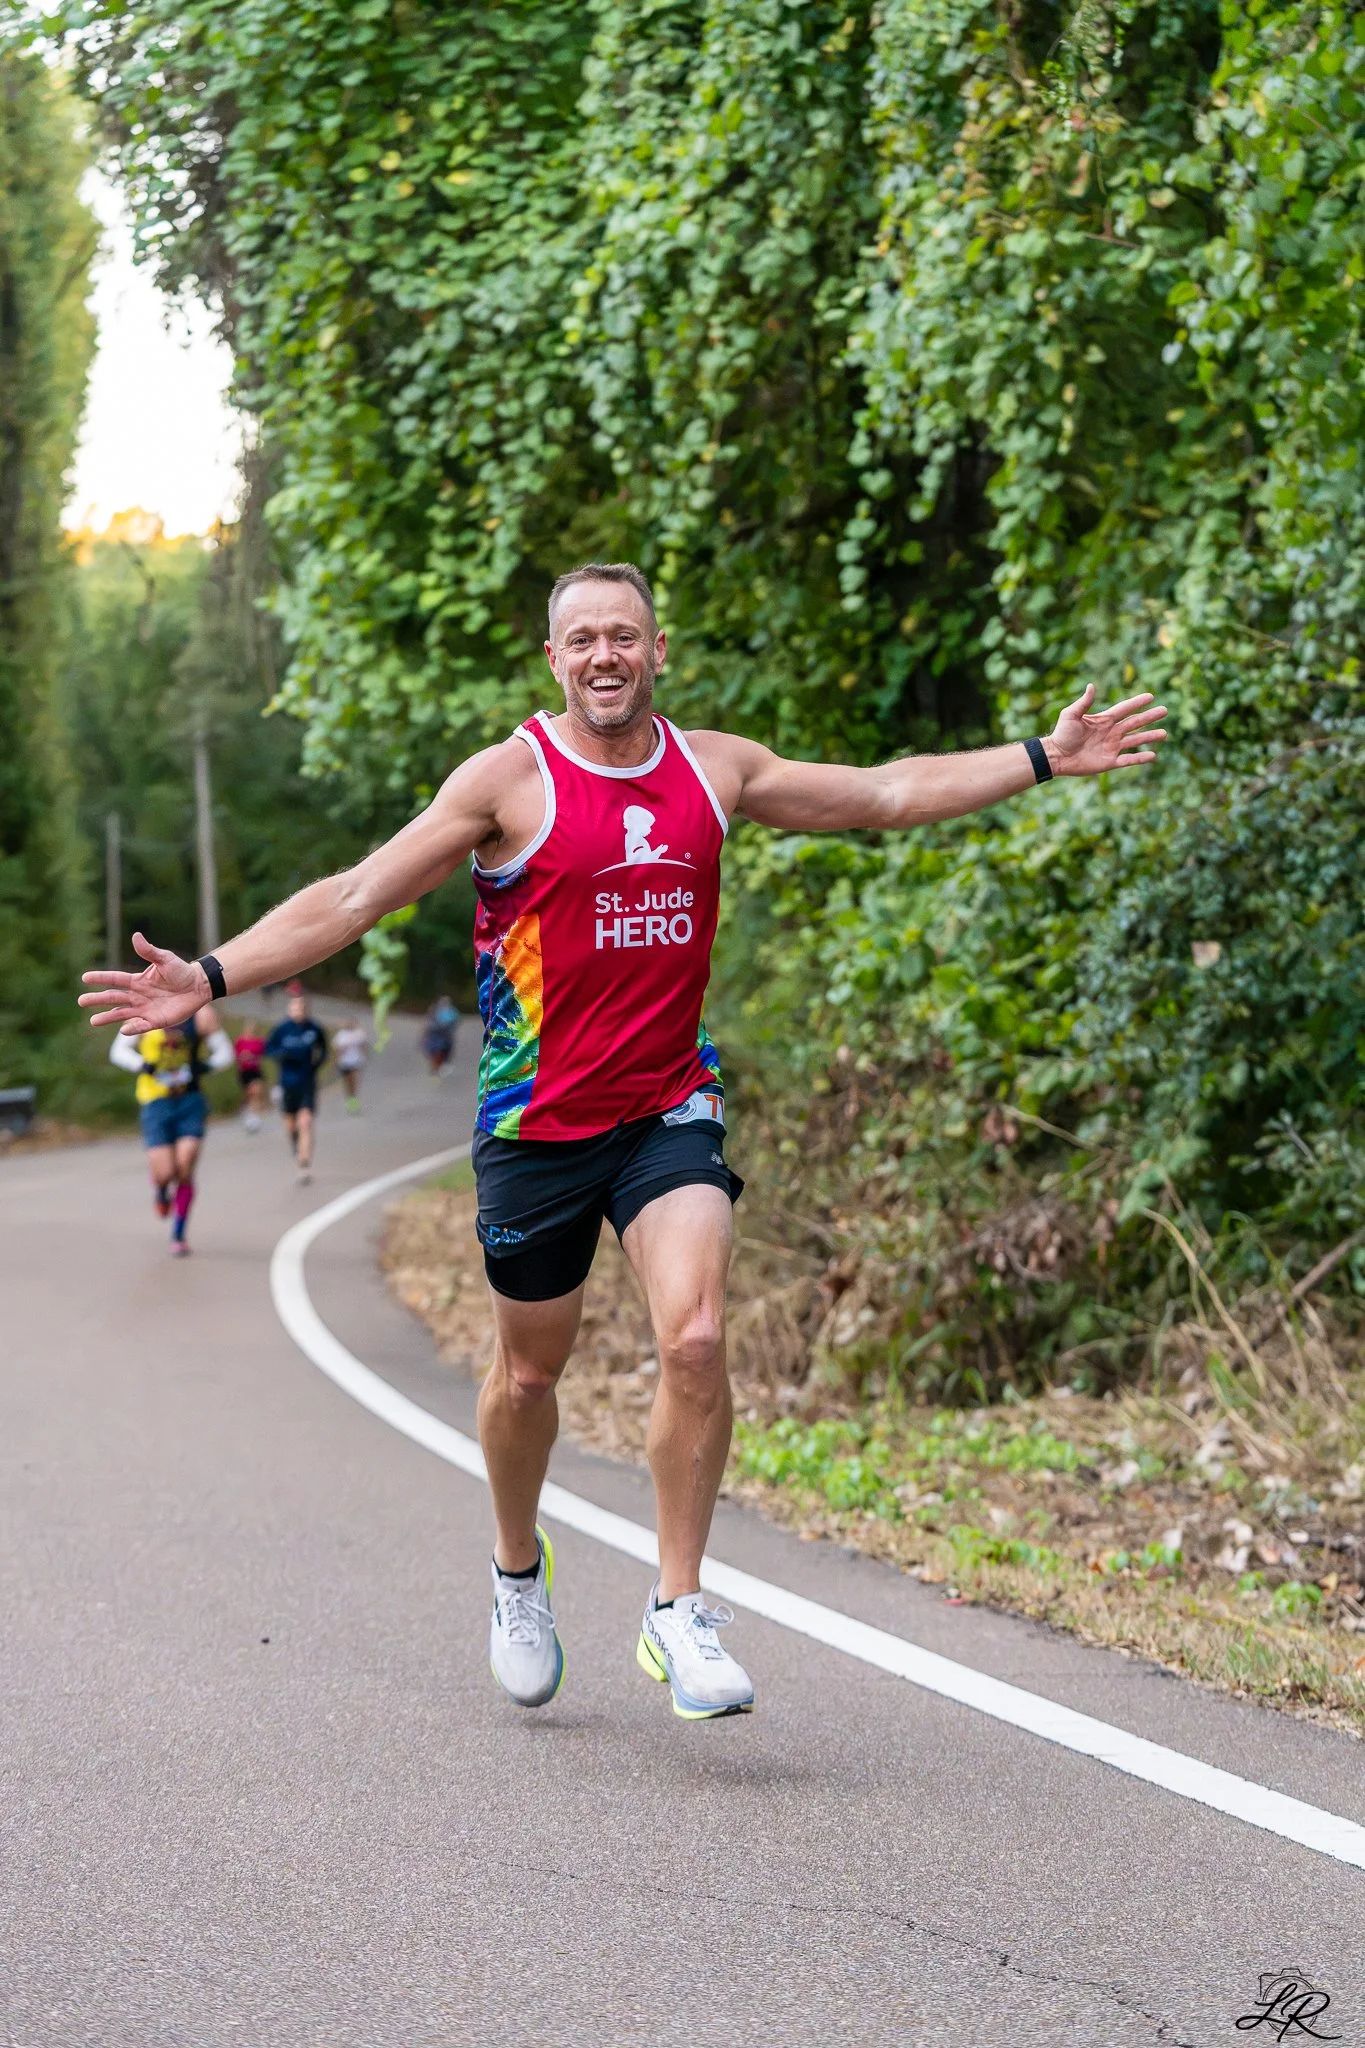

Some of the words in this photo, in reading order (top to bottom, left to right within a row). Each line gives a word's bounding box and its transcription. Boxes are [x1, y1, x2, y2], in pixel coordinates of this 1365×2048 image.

[595, 892, 630, 914] St.
[634, 886, 694, 911] Jude
[595, 912, 693, 950] HERO
